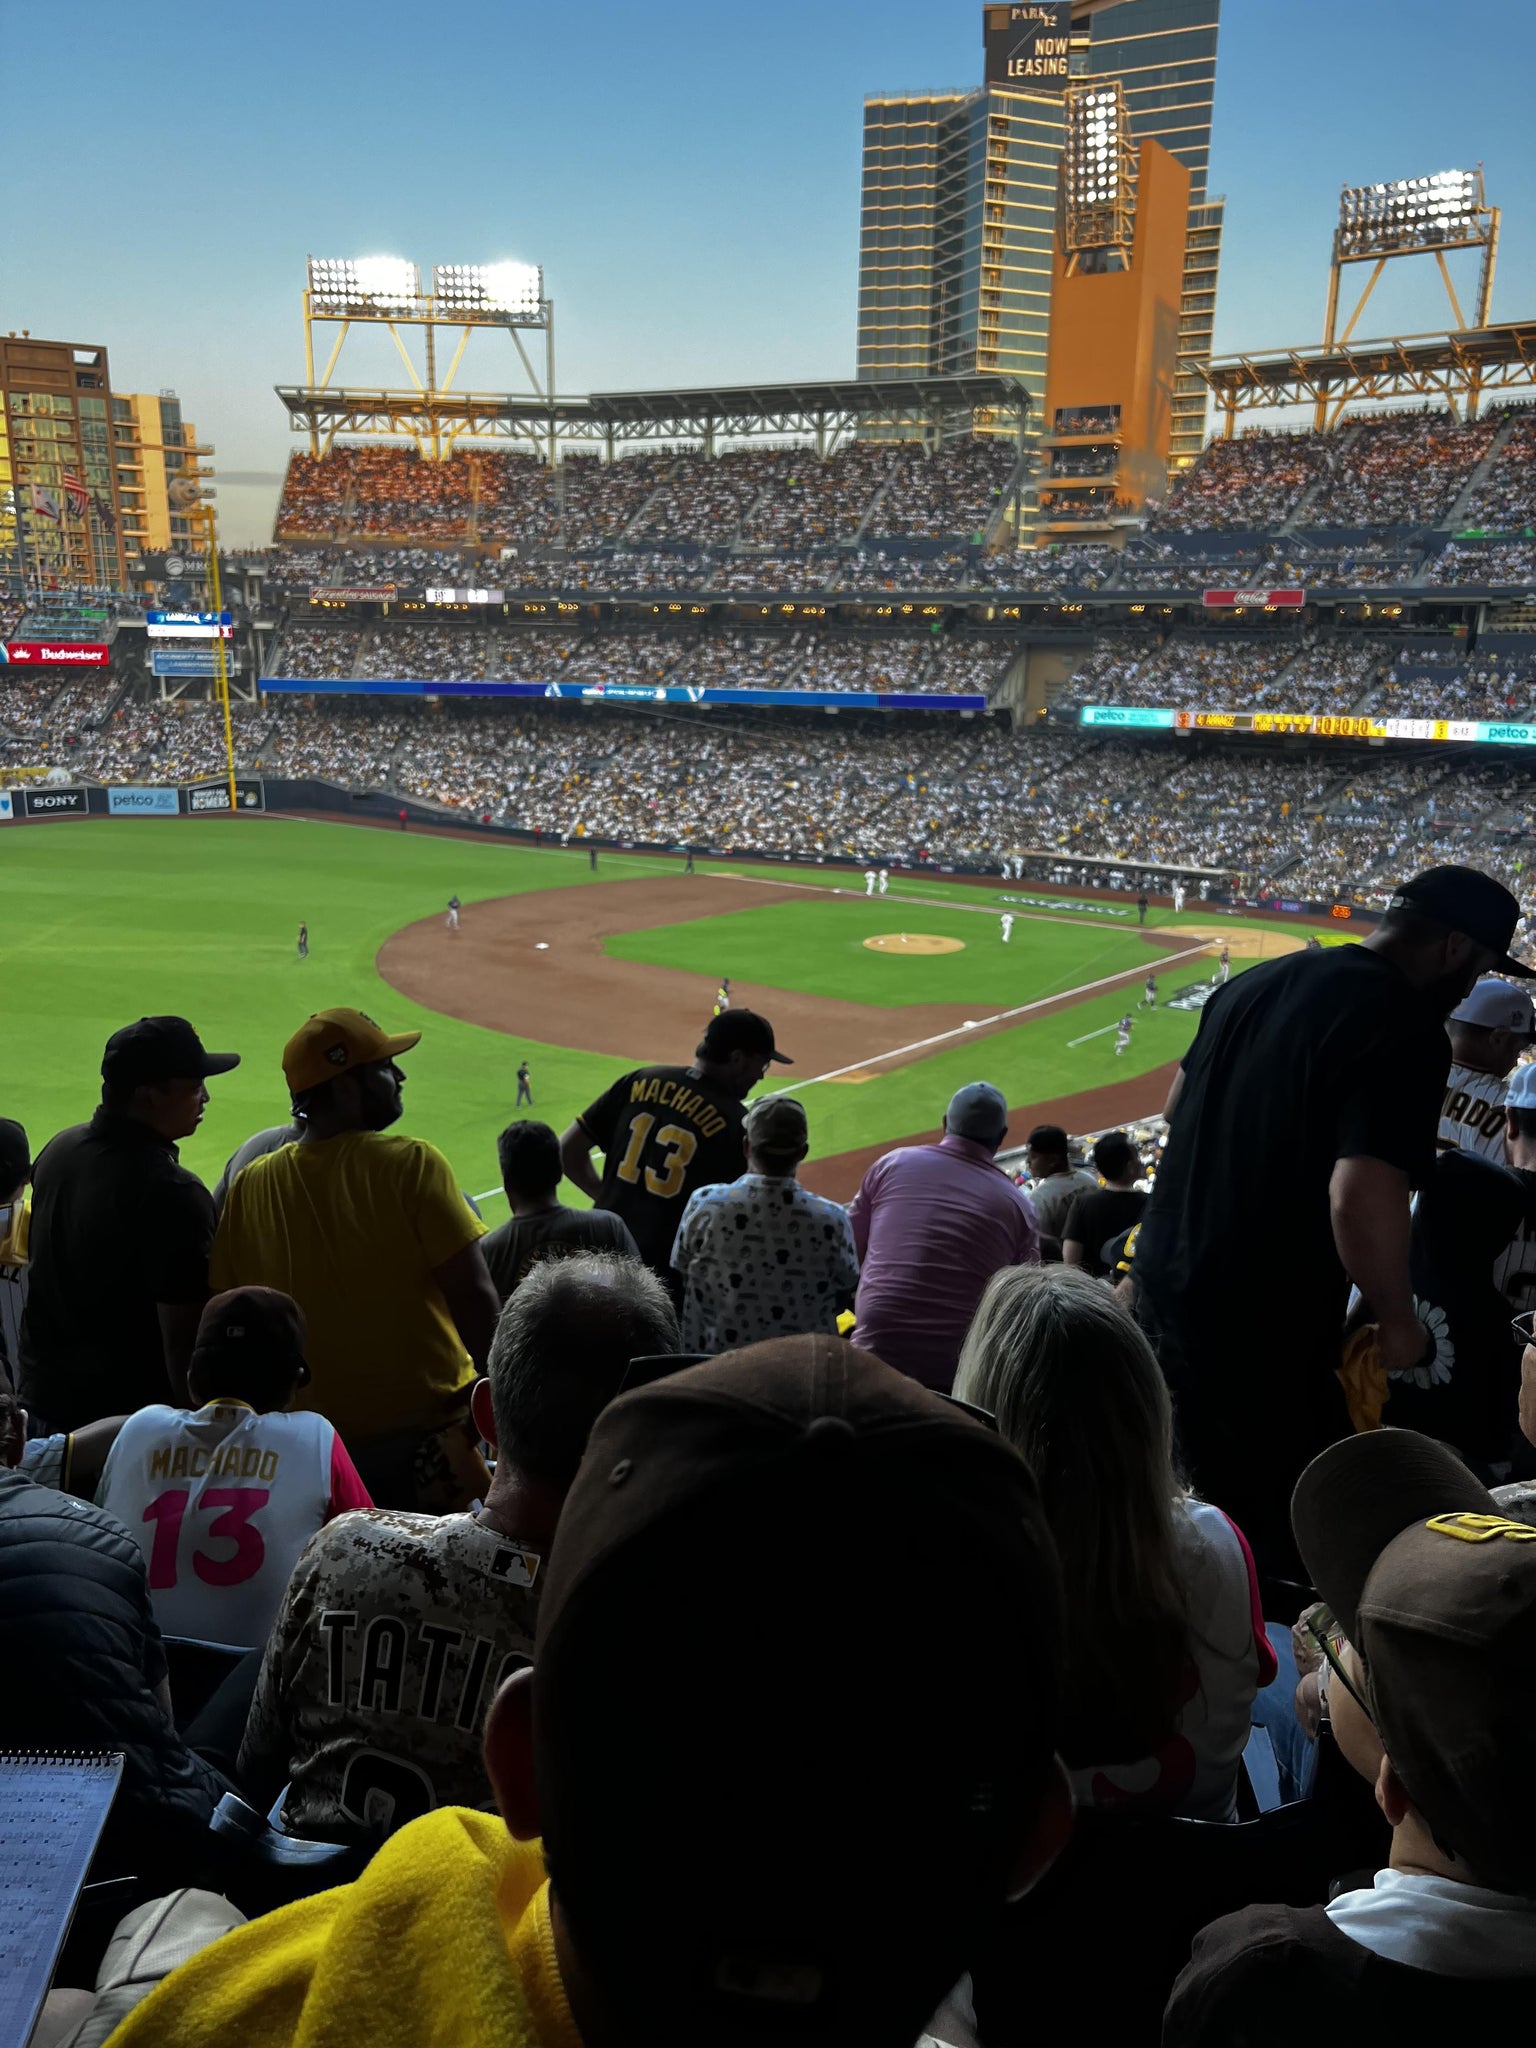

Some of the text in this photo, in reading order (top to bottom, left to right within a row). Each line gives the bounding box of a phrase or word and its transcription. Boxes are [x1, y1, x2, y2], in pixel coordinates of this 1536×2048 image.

[1035, 38, 1068, 56] NOW
[1008, 58, 1068, 76] LEASING
[40, 647, 103, 660] Budweiser
[1488, 726, 1528, 740] petco
[33, 795, 78, 808] SONY
[113, 793, 153, 807] petco
[630, 1078, 727, 1138] MACHADO
[617, 1112, 697, 1198] 13
[150, 1445, 280, 1482] MACHADO
[142, 1487, 269, 1589] 13
[319, 1609, 534, 1734] TATI
